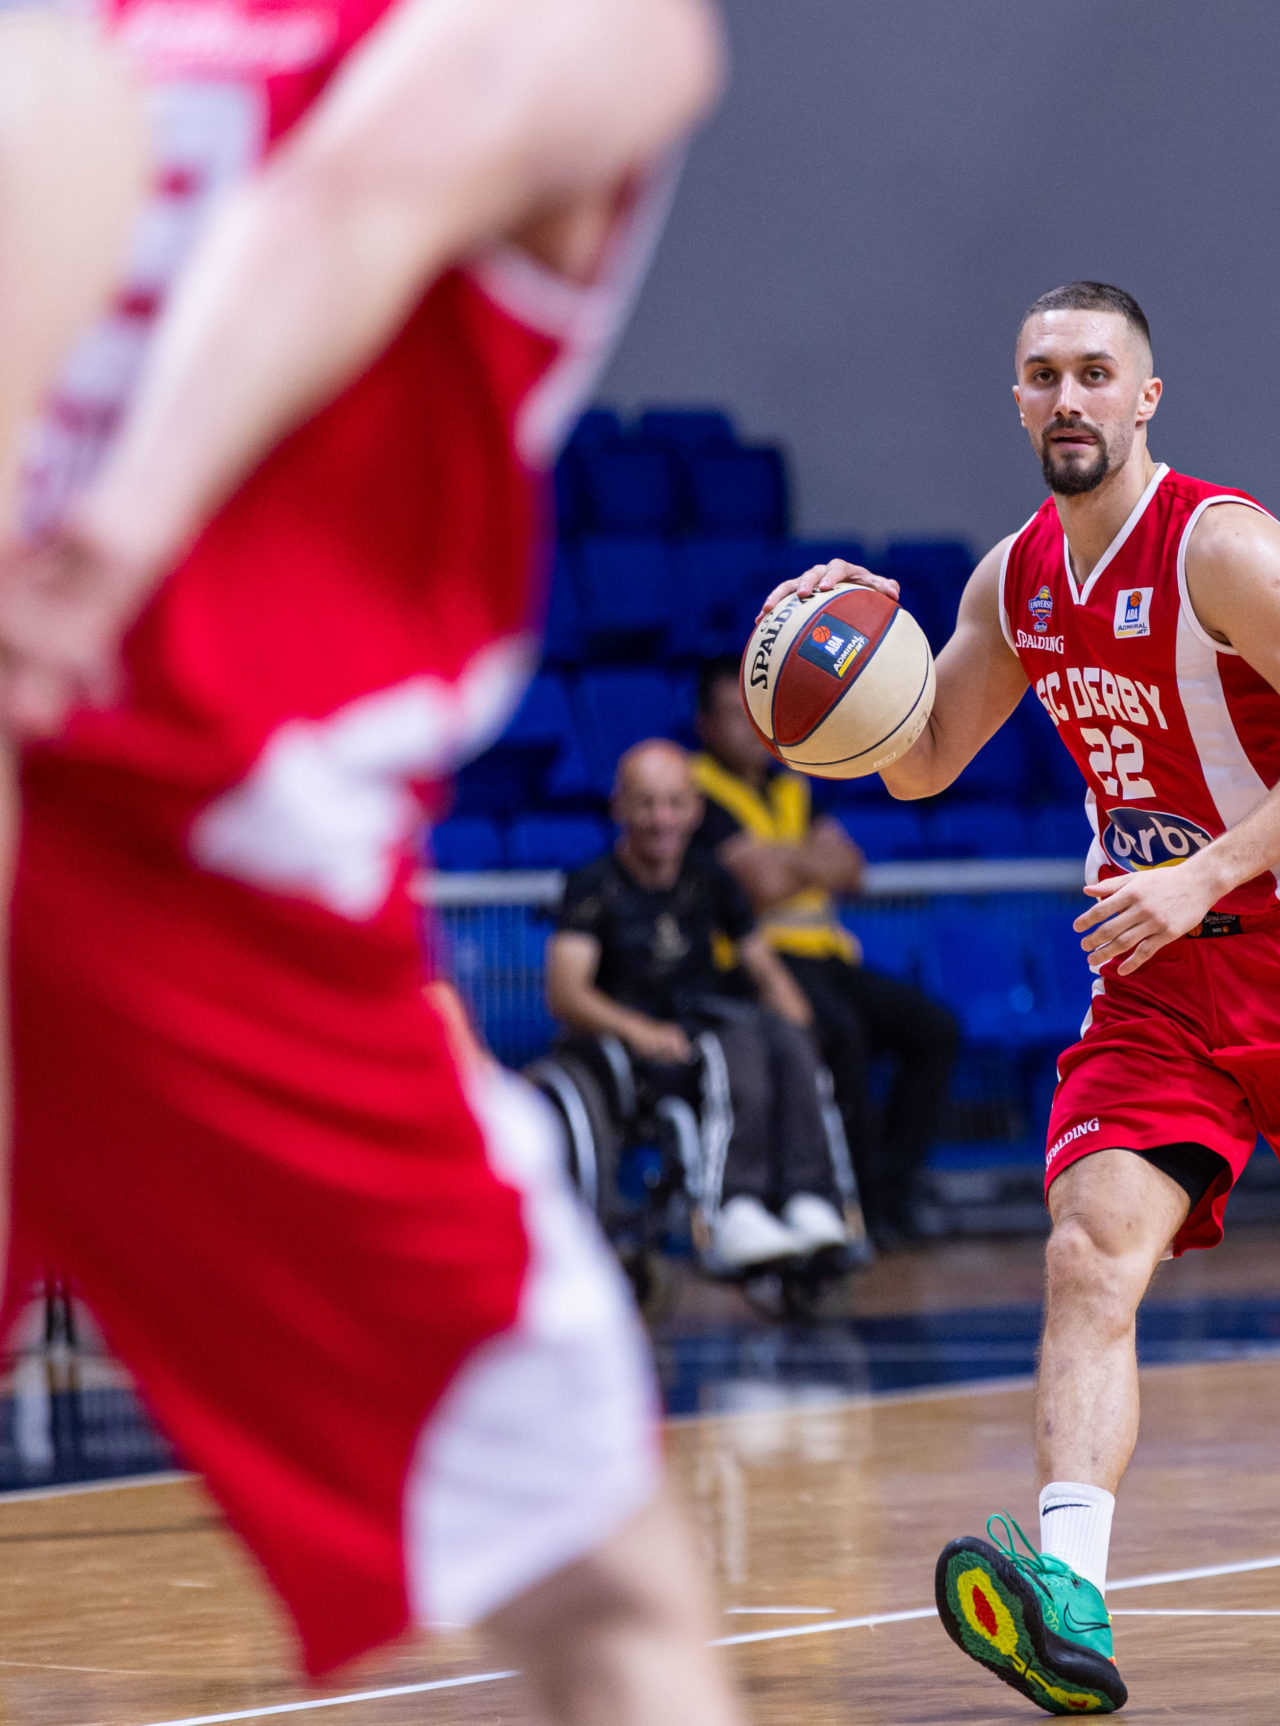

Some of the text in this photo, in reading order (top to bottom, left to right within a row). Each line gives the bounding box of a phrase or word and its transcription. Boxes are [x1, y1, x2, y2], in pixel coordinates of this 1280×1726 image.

[825, 635, 845, 656] ABA
[833, 635, 861, 672] ADMIRAL
[1015, 629, 1064, 655] SPALDING
[1065, 667, 1169, 730] DERBY
[1080, 725, 1157, 800] 22
